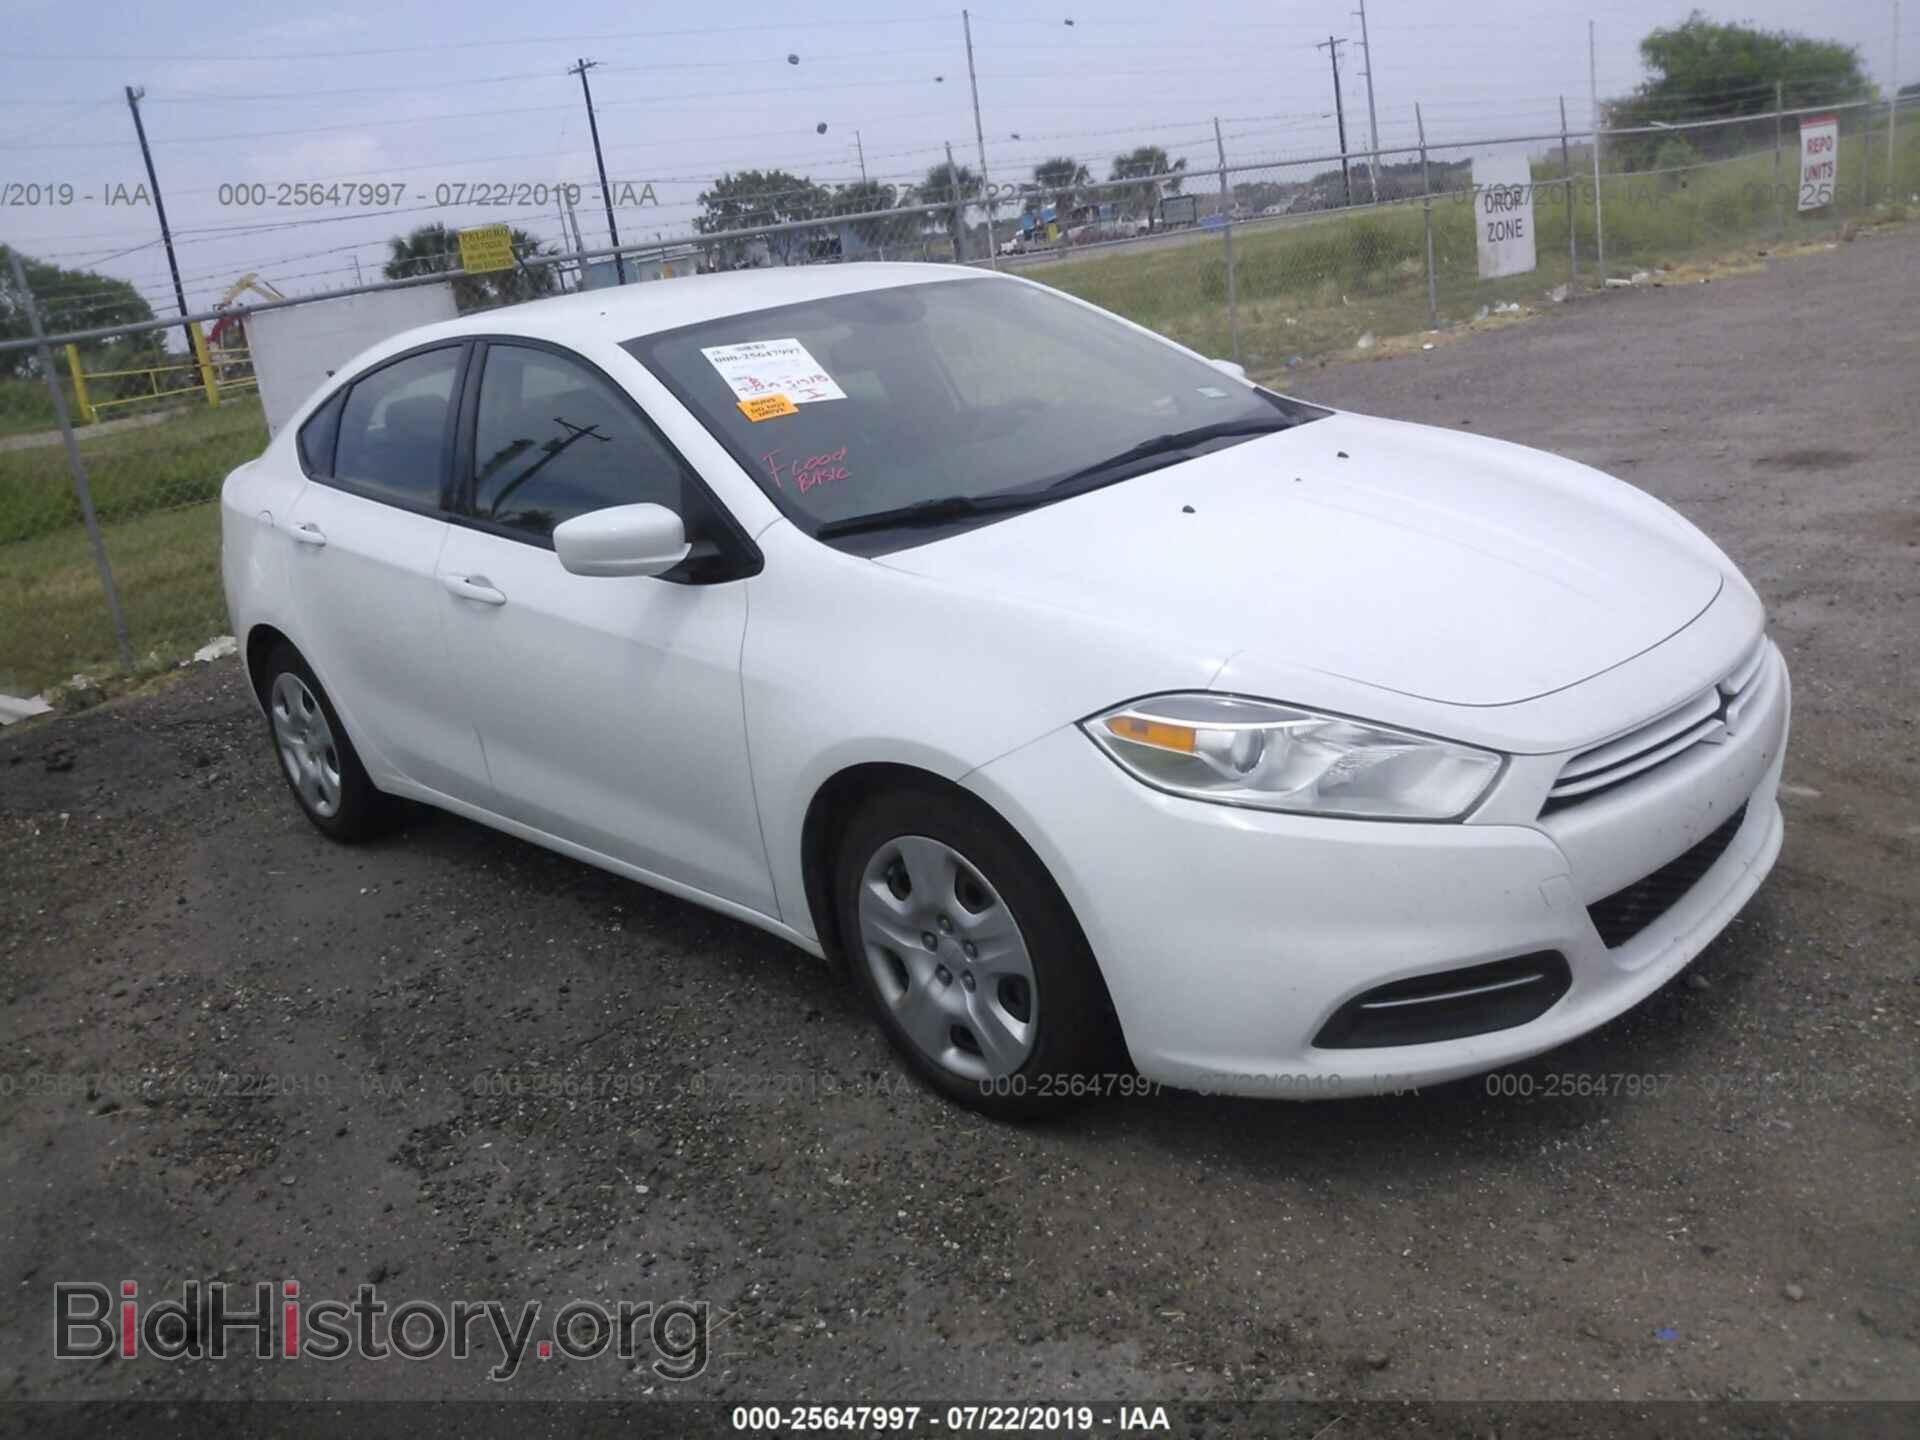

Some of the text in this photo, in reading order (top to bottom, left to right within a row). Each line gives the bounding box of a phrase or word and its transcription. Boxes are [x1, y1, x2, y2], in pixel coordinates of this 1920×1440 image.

[1806, 136, 1833, 154] REPO
[1803, 161, 1833, 182] UNITS
[1485, 191, 1521, 214] DROP
[1487, 219, 1524, 242] ZONE
